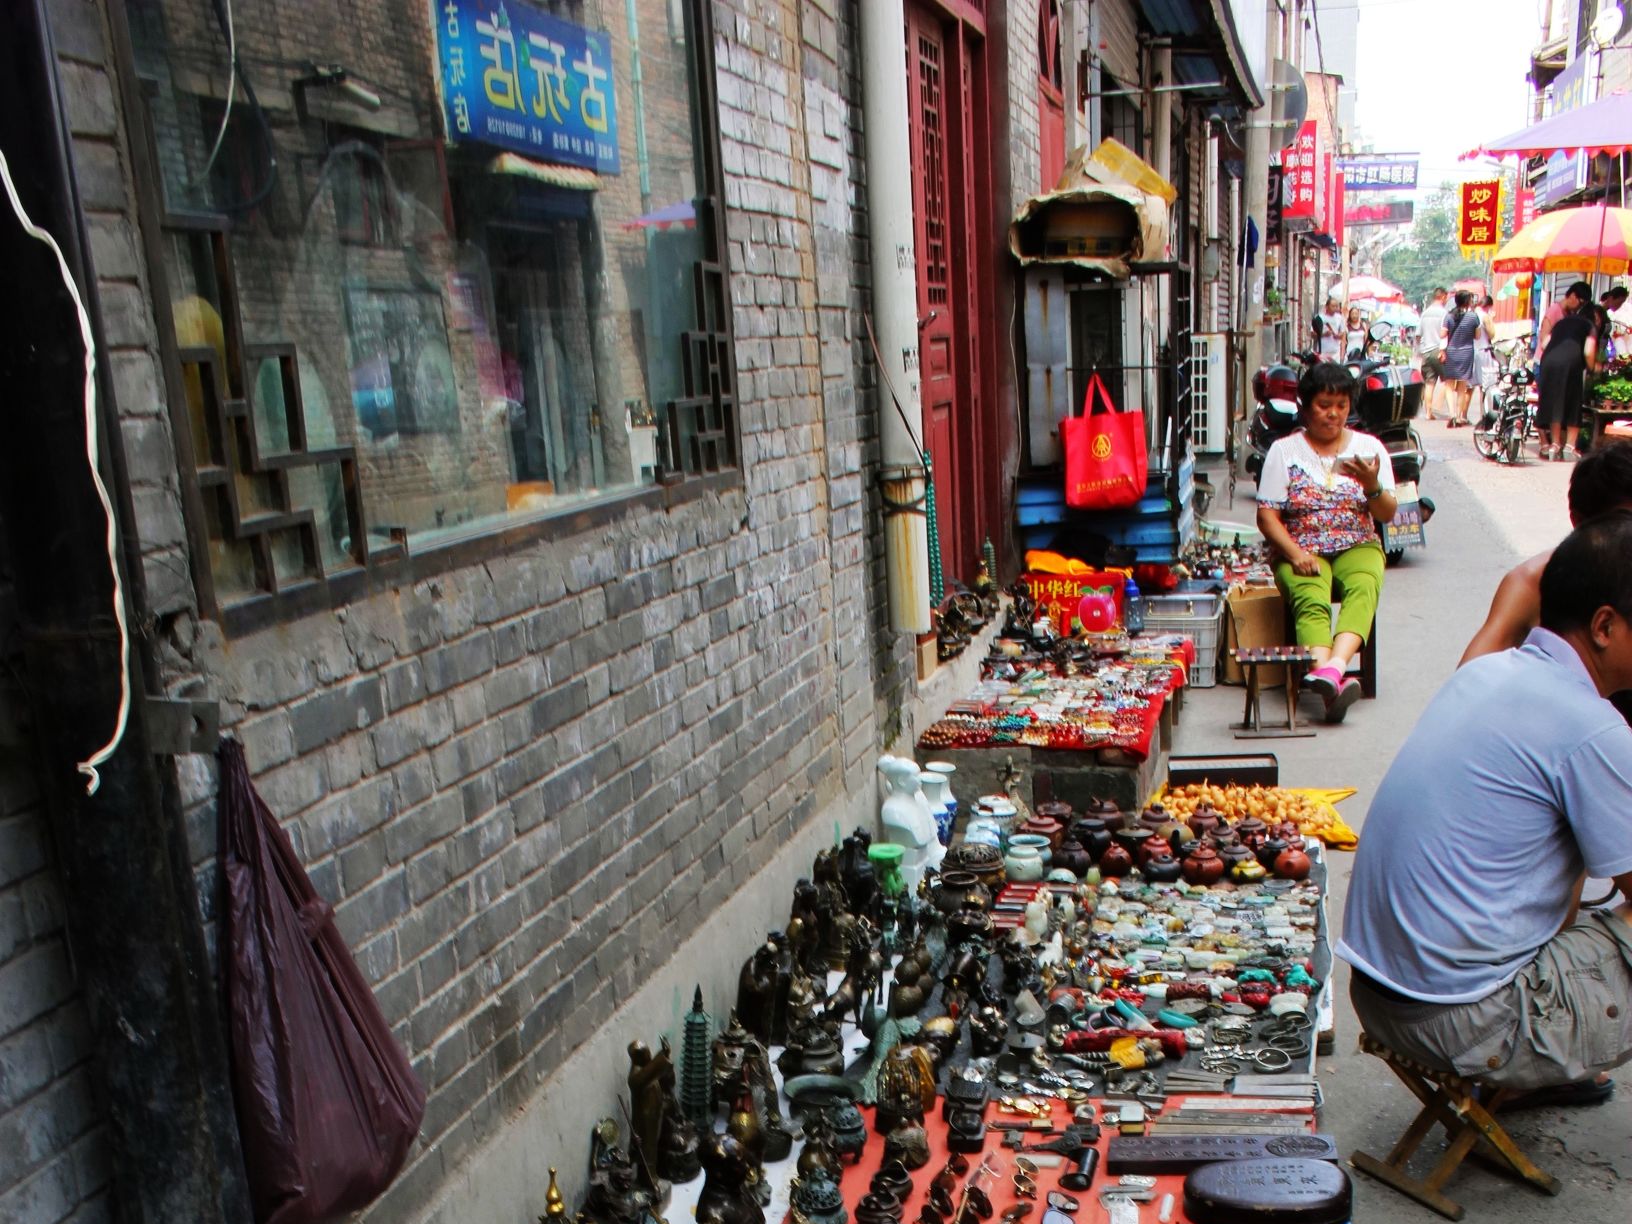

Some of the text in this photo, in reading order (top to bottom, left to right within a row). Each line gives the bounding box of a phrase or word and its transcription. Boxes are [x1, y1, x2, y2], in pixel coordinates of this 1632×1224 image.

[1299, 134, 1314, 202] 欢迎选购
[1337, 165, 1415, 184] 阳市肛肠医院
[1467, 188, 1492, 242] 炒味居
[1027, 579, 1082, 599] 中华红
